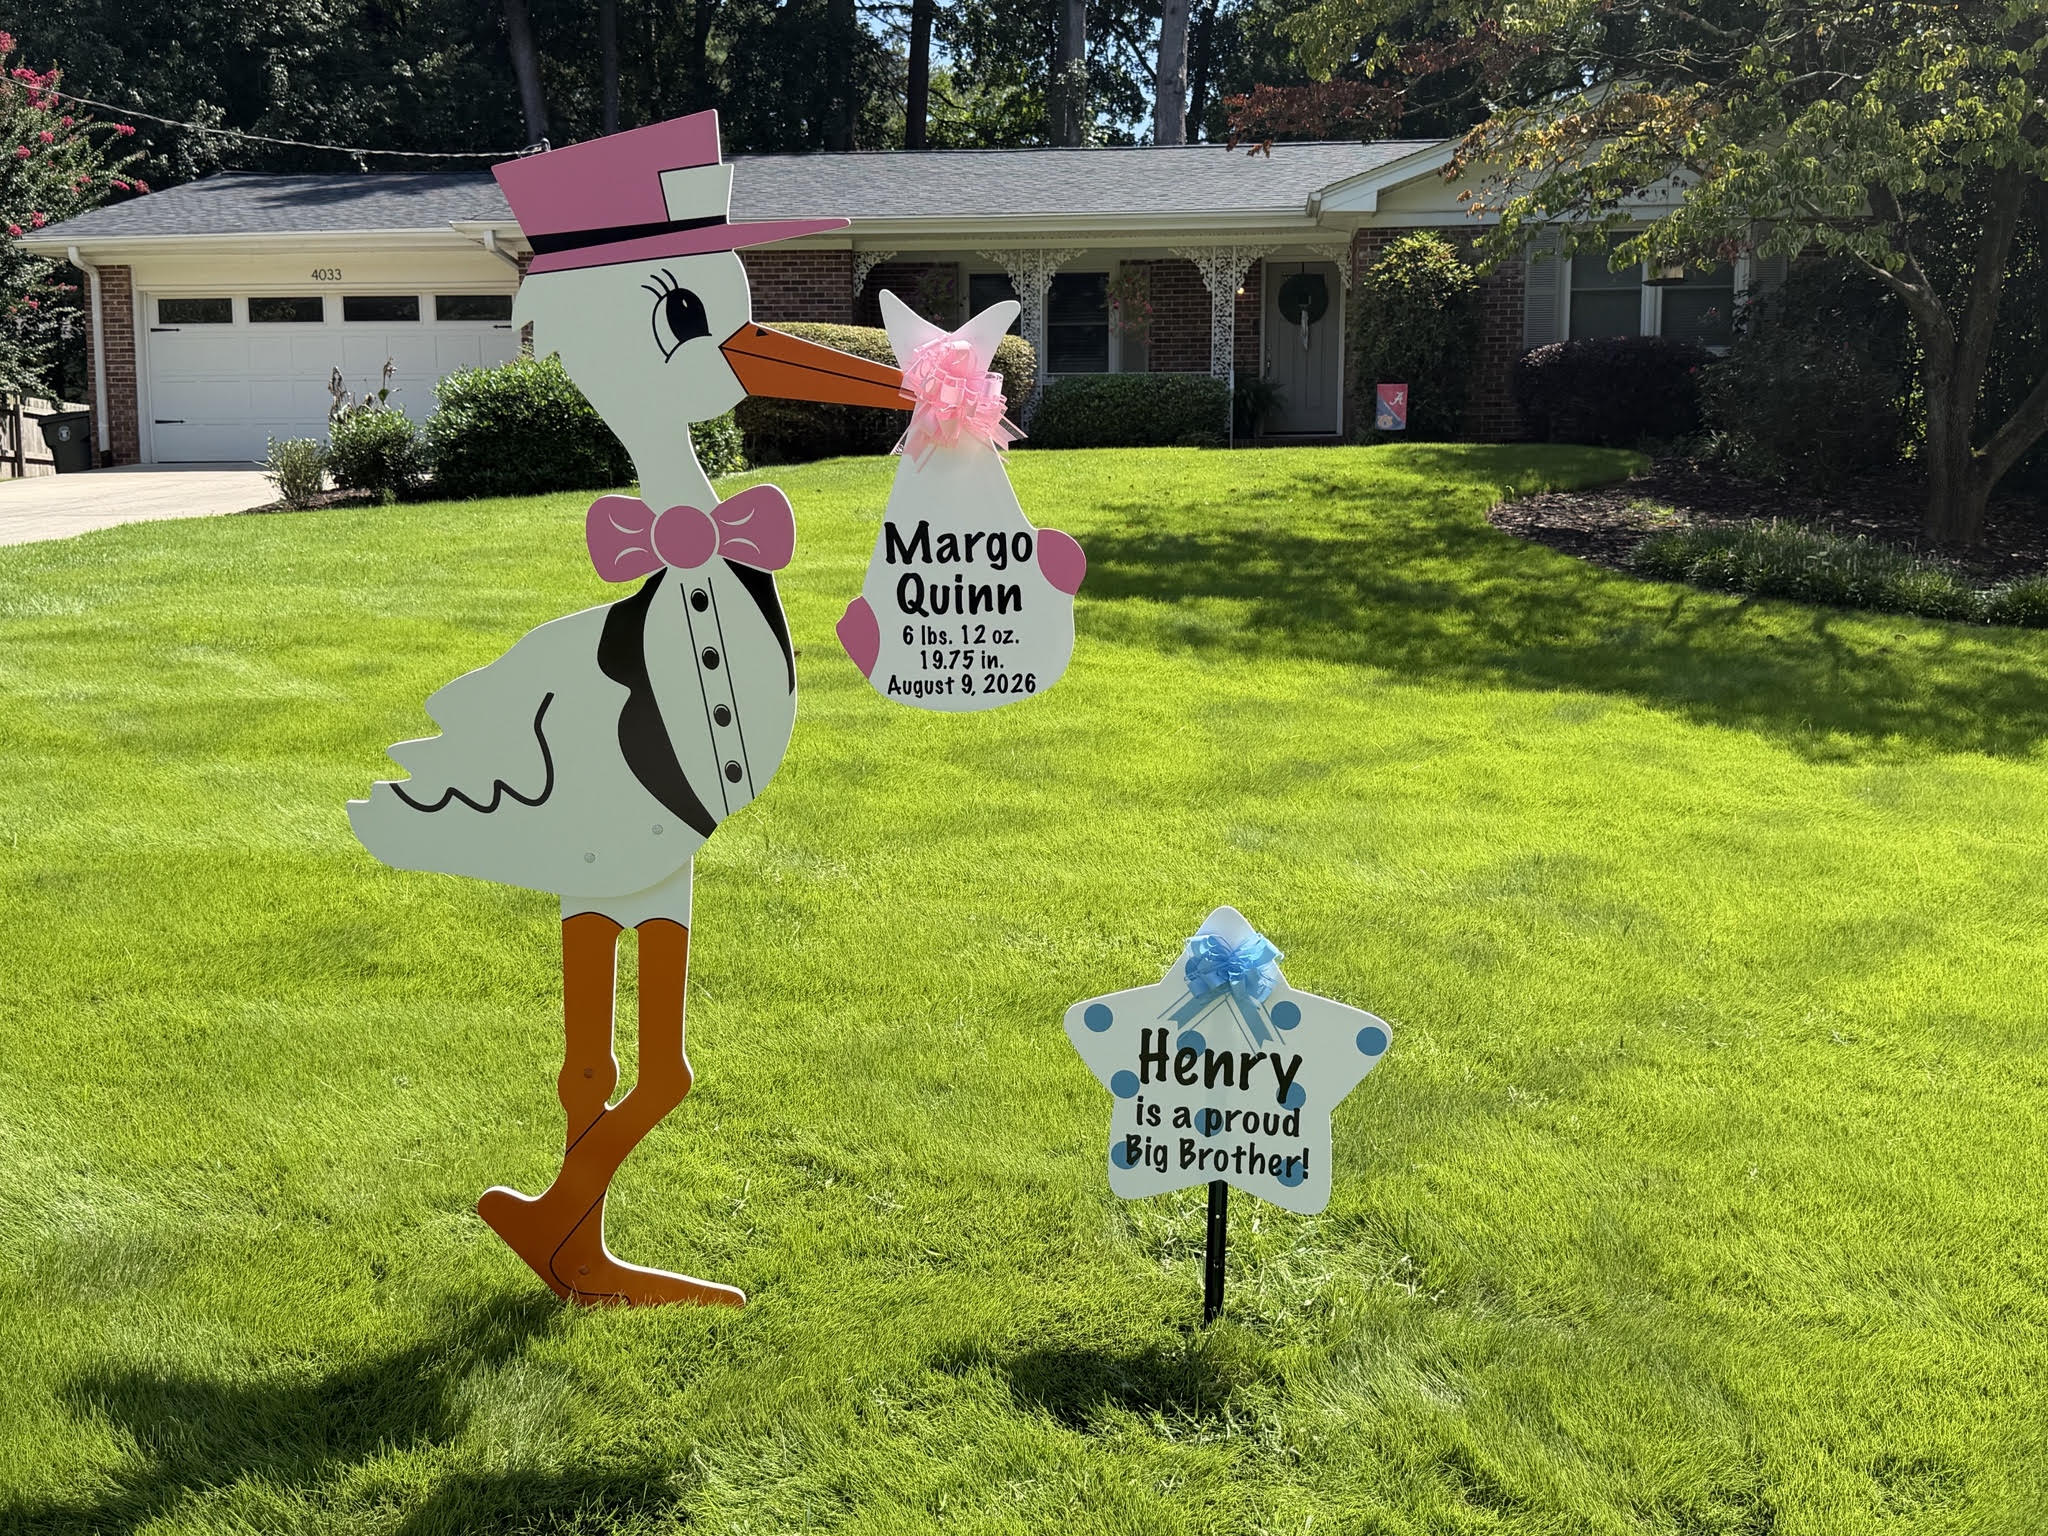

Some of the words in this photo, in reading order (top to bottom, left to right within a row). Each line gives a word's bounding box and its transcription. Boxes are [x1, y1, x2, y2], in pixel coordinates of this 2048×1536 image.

[311, 268, 342, 281] 4033
[883, 520, 1033, 571] Margo
[896, 572, 1023, 618] Quinn
[902, 624, 914, 646] 6
[921, 624, 953, 646] lbs.
[961, 624, 987, 645] 12
[992, 629, 1020, 645] oz.
[920, 649, 975, 671] 19.75
[981, 649, 1004, 670] in.
[887, 674, 955, 699] August
[961, 673, 976, 697] 9,
[982, 672, 1037, 695] 2026
[1138, 1027, 1303, 1105] Henry
[1136, 1095, 1162, 1127] is
[1172, 1106, 1192, 1129] a
[1204, 1107, 1301, 1138] proud
[1125, 1133, 1168, 1174] Big
[1179, 1137, 1310, 1180] Brother!
